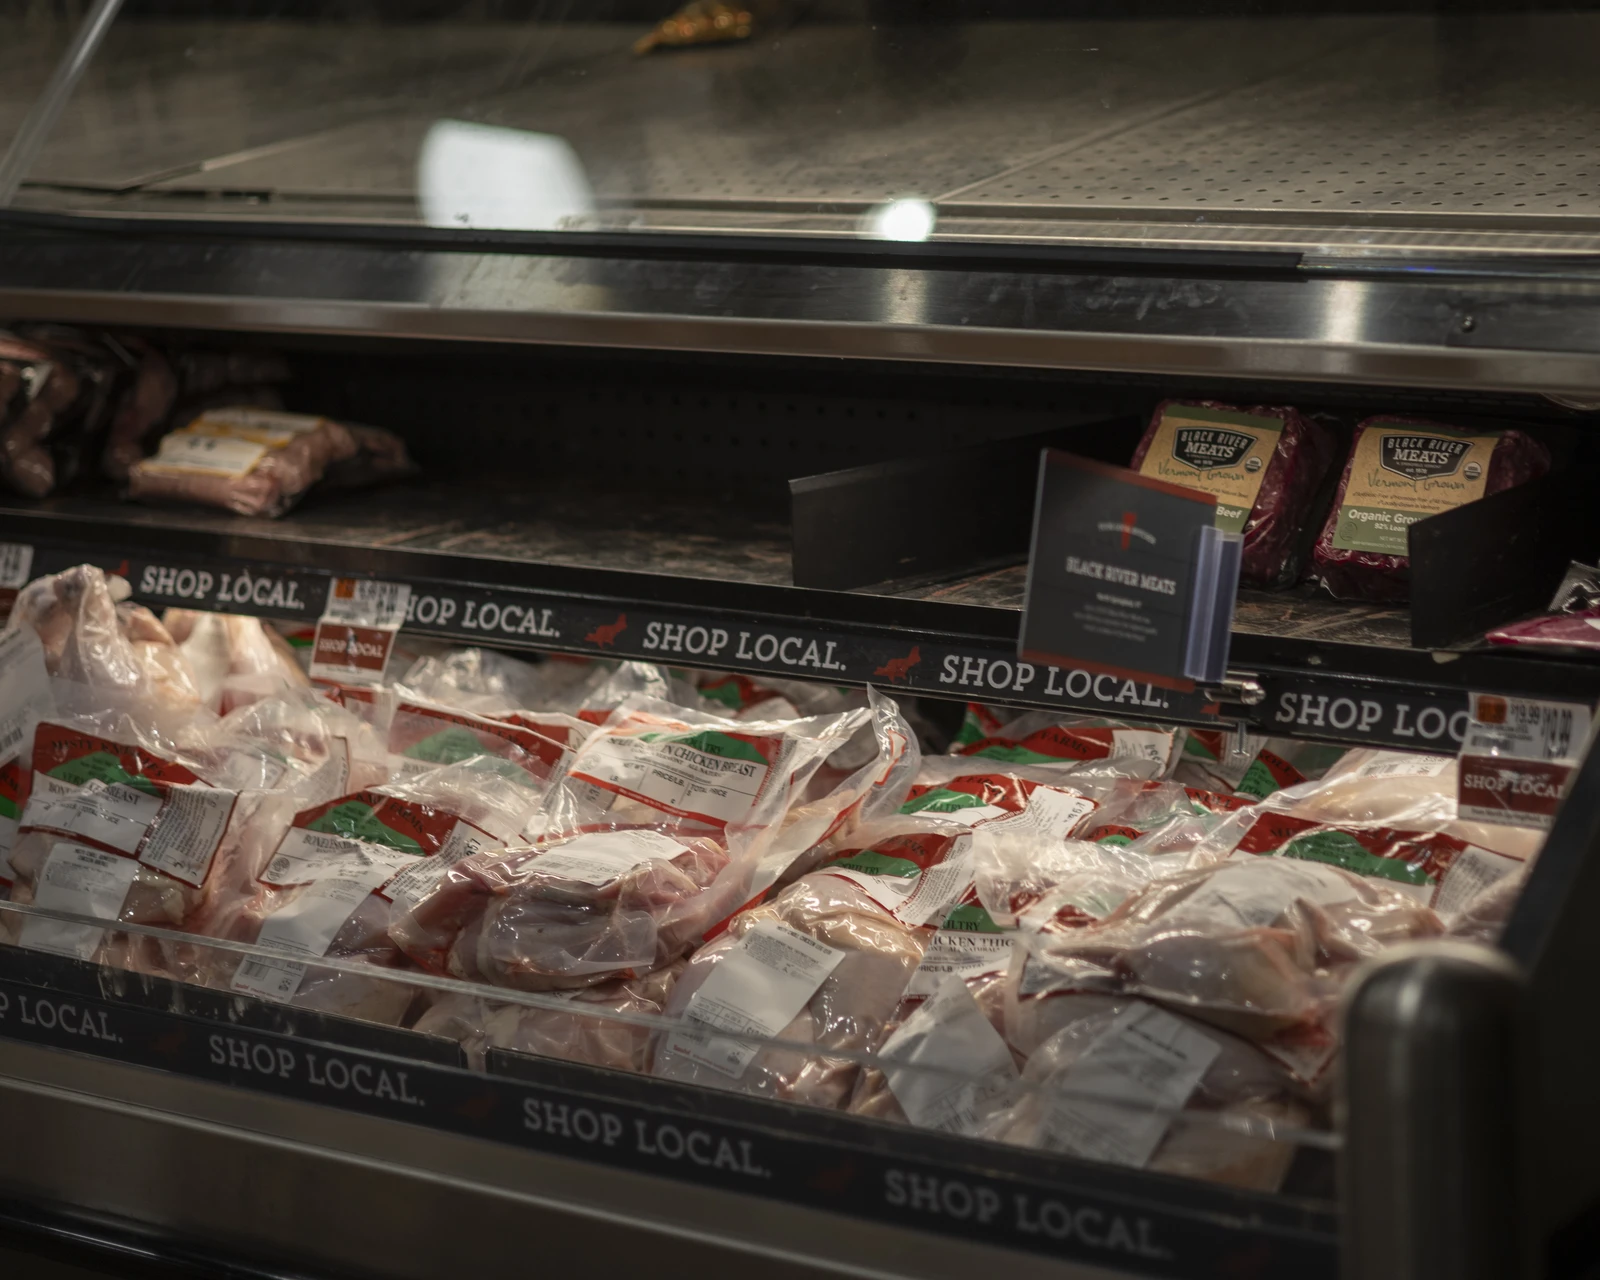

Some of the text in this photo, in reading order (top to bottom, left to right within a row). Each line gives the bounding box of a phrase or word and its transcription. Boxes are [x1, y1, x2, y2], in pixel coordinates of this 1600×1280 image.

[1181, 431, 1248, 449] BLACK RIVER
[1184, 441, 1235, 458] MEATS
[1387, 438, 1464, 455] BLACK RIVER
[1392, 448, 1450, 465] MEATS
[1216, 506, 1243, 519] Beef
[1348, 509, 1391, 522] Organic
[140, 566, 214, 600] SHOP
[217, 574, 305, 611] LOCAL.
[1066, 556, 1177, 595] BLACK RIVER MEATS
[404, 594, 456, 626] HOP
[461, 601, 561, 638] LOCAL.
[643, 622, 847, 671] SHOP LOCAL.
[939, 655, 1169, 709] SHOP LOCAL.
[1275, 692, 1383, 732] SHOP
[1393, 704, 1471, 742] LOC
[673, 746, 721, 772] CHICKEN
[720, 761, 757, 778] BREAST
[1463, 774, 1508, 792] SHOP
[931, 935, 1015, 948] ICKEN THIG
[943, 920, 981, 931] ULTRY
[18, 995, 124, 1044] LOCAL.
[209, 1035, 426, 1106] SHOP LOCAL.
[523, 1098, 773, 1178] SHOP LOCAL.
[885, 1169, 1174, 1258] SHOP LOCAL.
